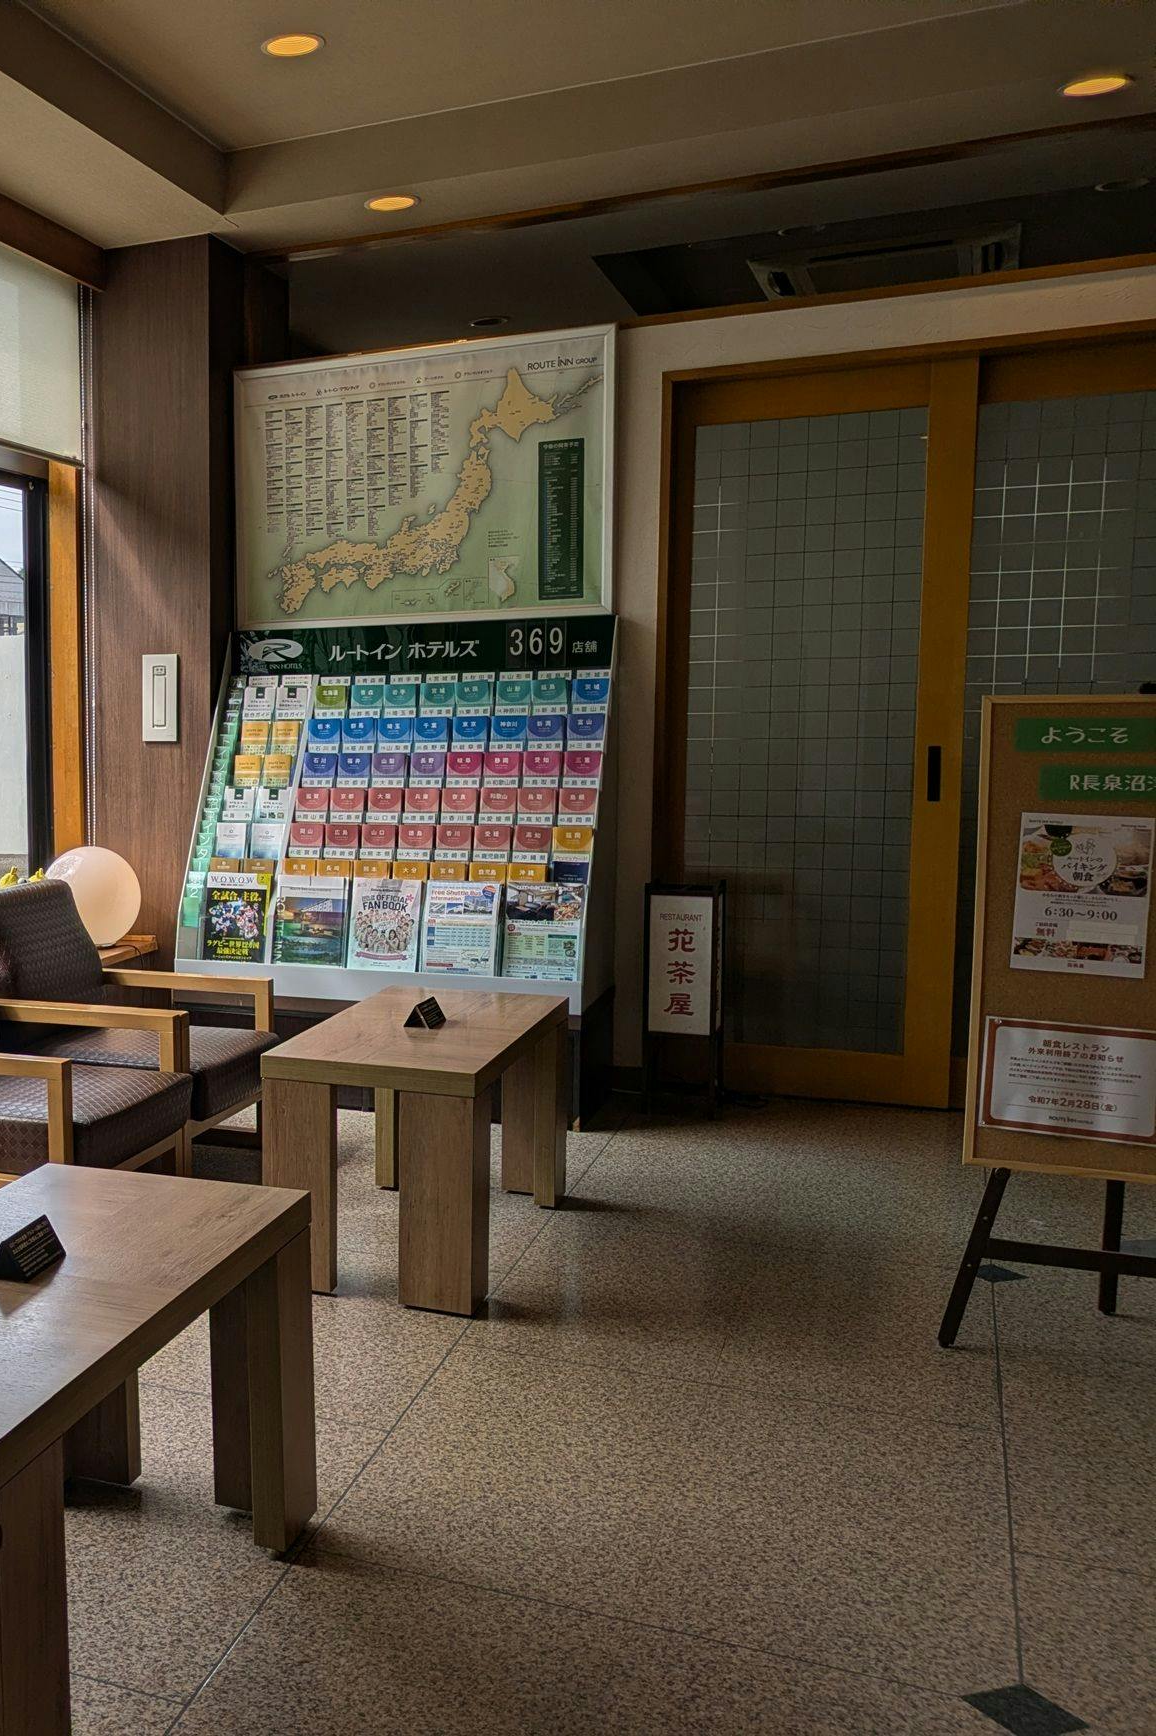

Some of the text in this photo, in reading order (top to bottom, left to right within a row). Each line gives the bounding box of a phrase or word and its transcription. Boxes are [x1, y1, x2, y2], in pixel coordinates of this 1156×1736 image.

[528, 360, 556, 371] ROUTE
[575, 357, 598, 365] GROUP
[328, 627, 598, 662] ルートイン ホテルズ 369 店舗
[281, 662, 303, 670] HOTELS
[1040, 726, 1130, 744] ようこそ
[1061, 862, 1107, 872] バイキング
[1072, 872, 1095, 882] 朝食
[376, 894, 408, 904] OFFICIAL
[363, 901, 408, 912] FAN BOOK
[659, 913, 703, 923] RESTAURANT
[663, 928, 696, 1016] 花茶屋
[1042, 1039, 1110, 1053] 朝食レストラン
[1028, 1047, 1125, 1063] 外来利用終了のお知らせ
[1028, 1095, 1118, 1112] 令和7年2月28日(金)
